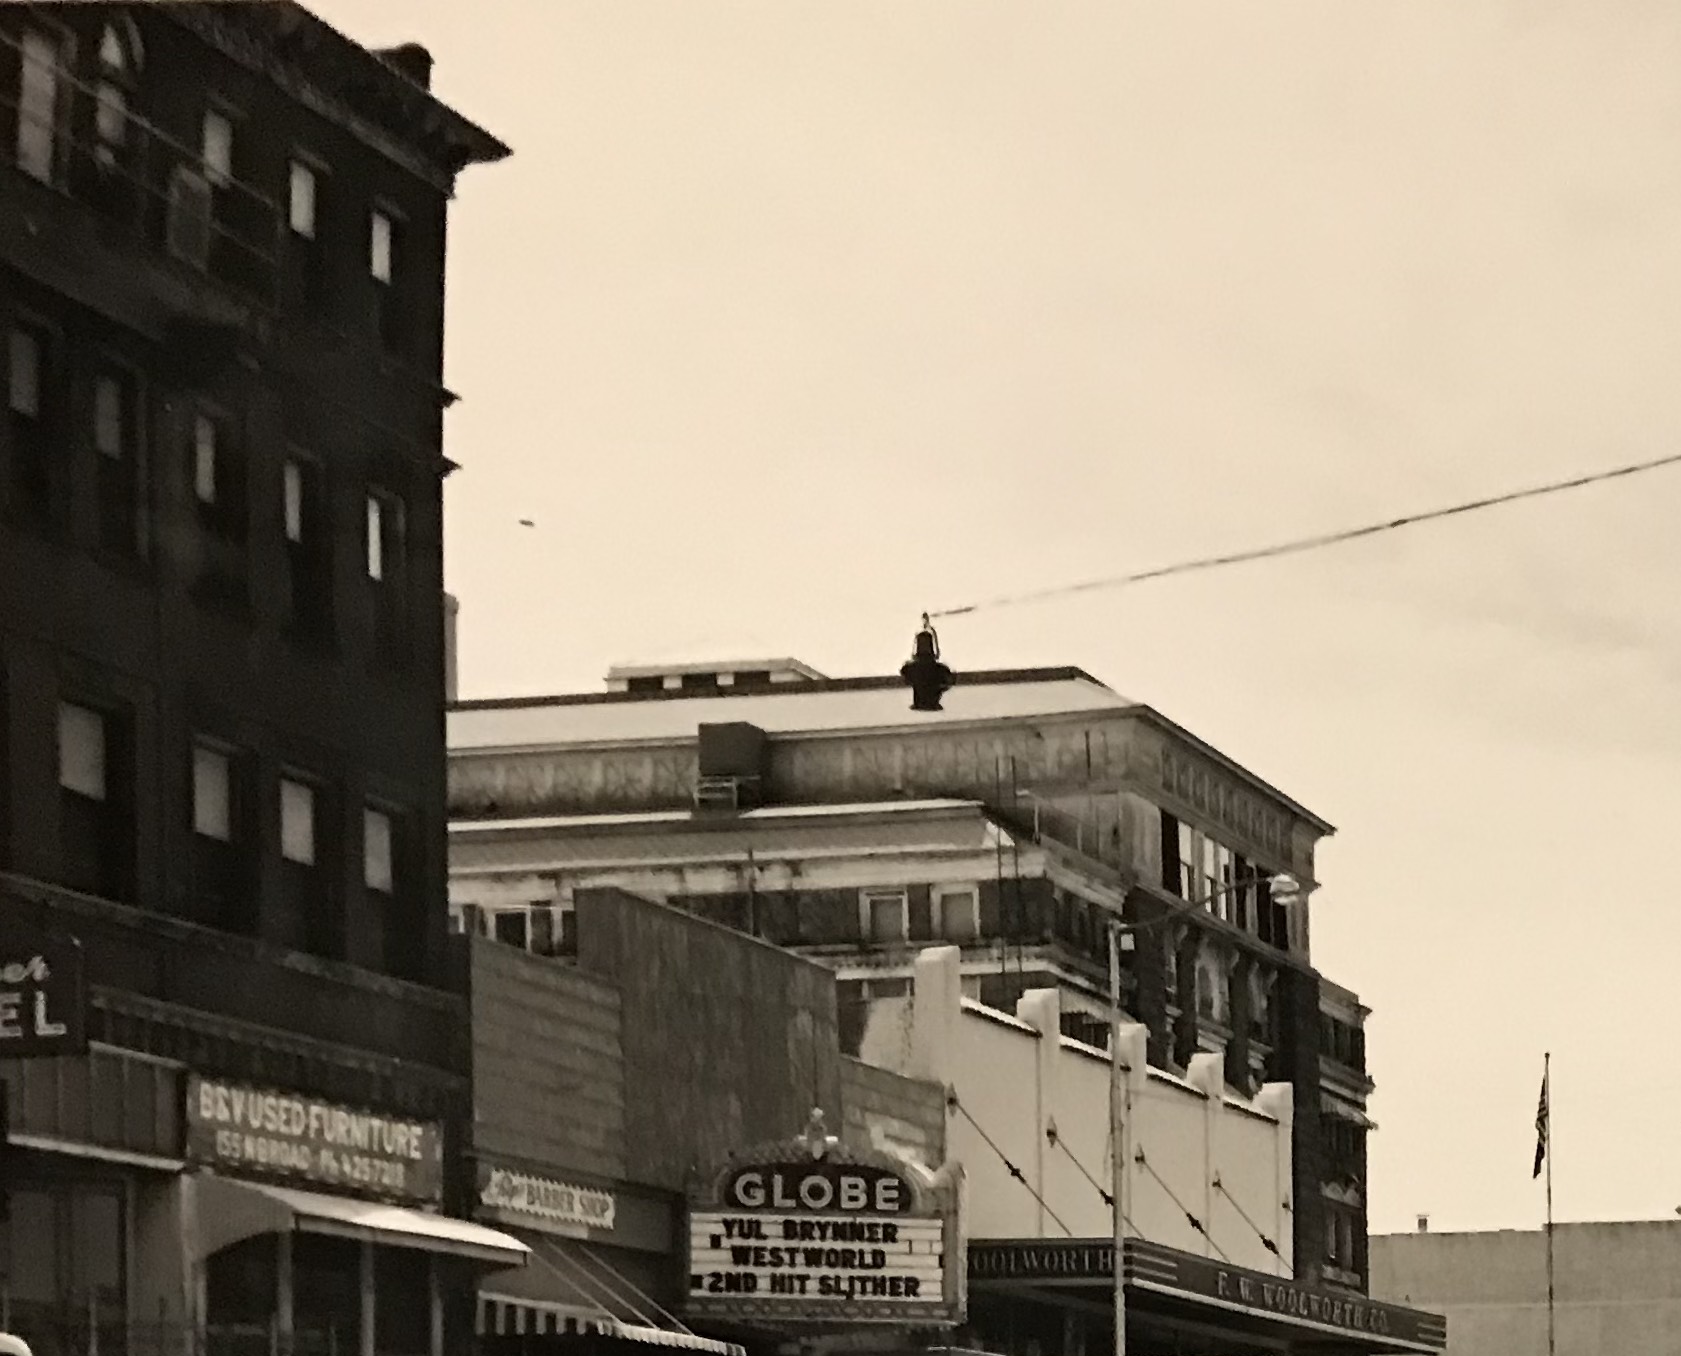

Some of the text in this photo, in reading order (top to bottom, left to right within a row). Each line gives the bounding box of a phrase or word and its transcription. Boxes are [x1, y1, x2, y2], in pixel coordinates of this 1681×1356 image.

[248, 1093, 306, 1136] USED
[309, 1104, 423, 1160] FURNITURE
[526, 1183, 575, 1214] BARBER
[735, 1172, 900, 1211] GLOBE
[722, 1218, 899, 1243] YUL BRYNNER
[731, 1245, 886, 1269] WESTWORLD
[707, 1272, 920, 1300] 2ND HIT SLITHER
[1263, 1283, 1365, 1329] WOOLWORTH
